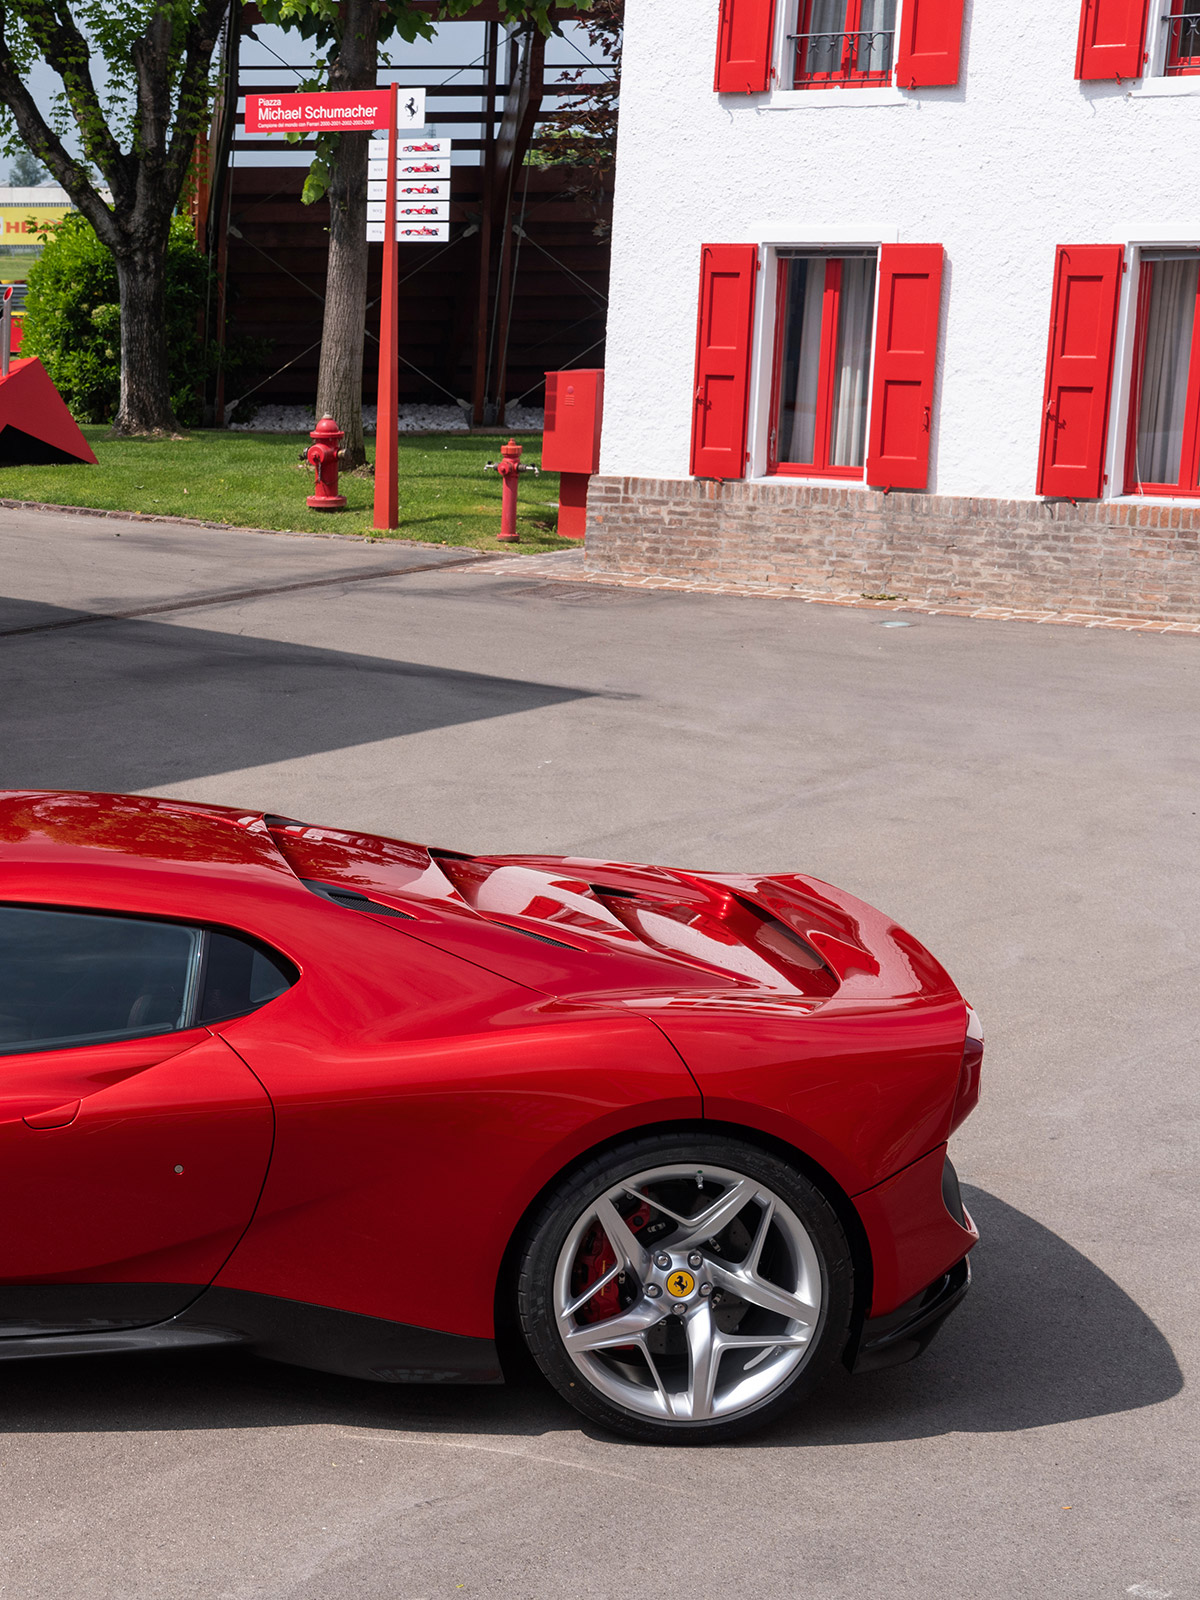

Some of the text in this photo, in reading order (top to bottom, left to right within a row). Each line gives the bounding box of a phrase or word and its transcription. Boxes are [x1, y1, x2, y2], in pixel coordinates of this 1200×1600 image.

[258, 98, 282, 106] Piazza
[258, 105, 378, 120] Michael Schumacher
